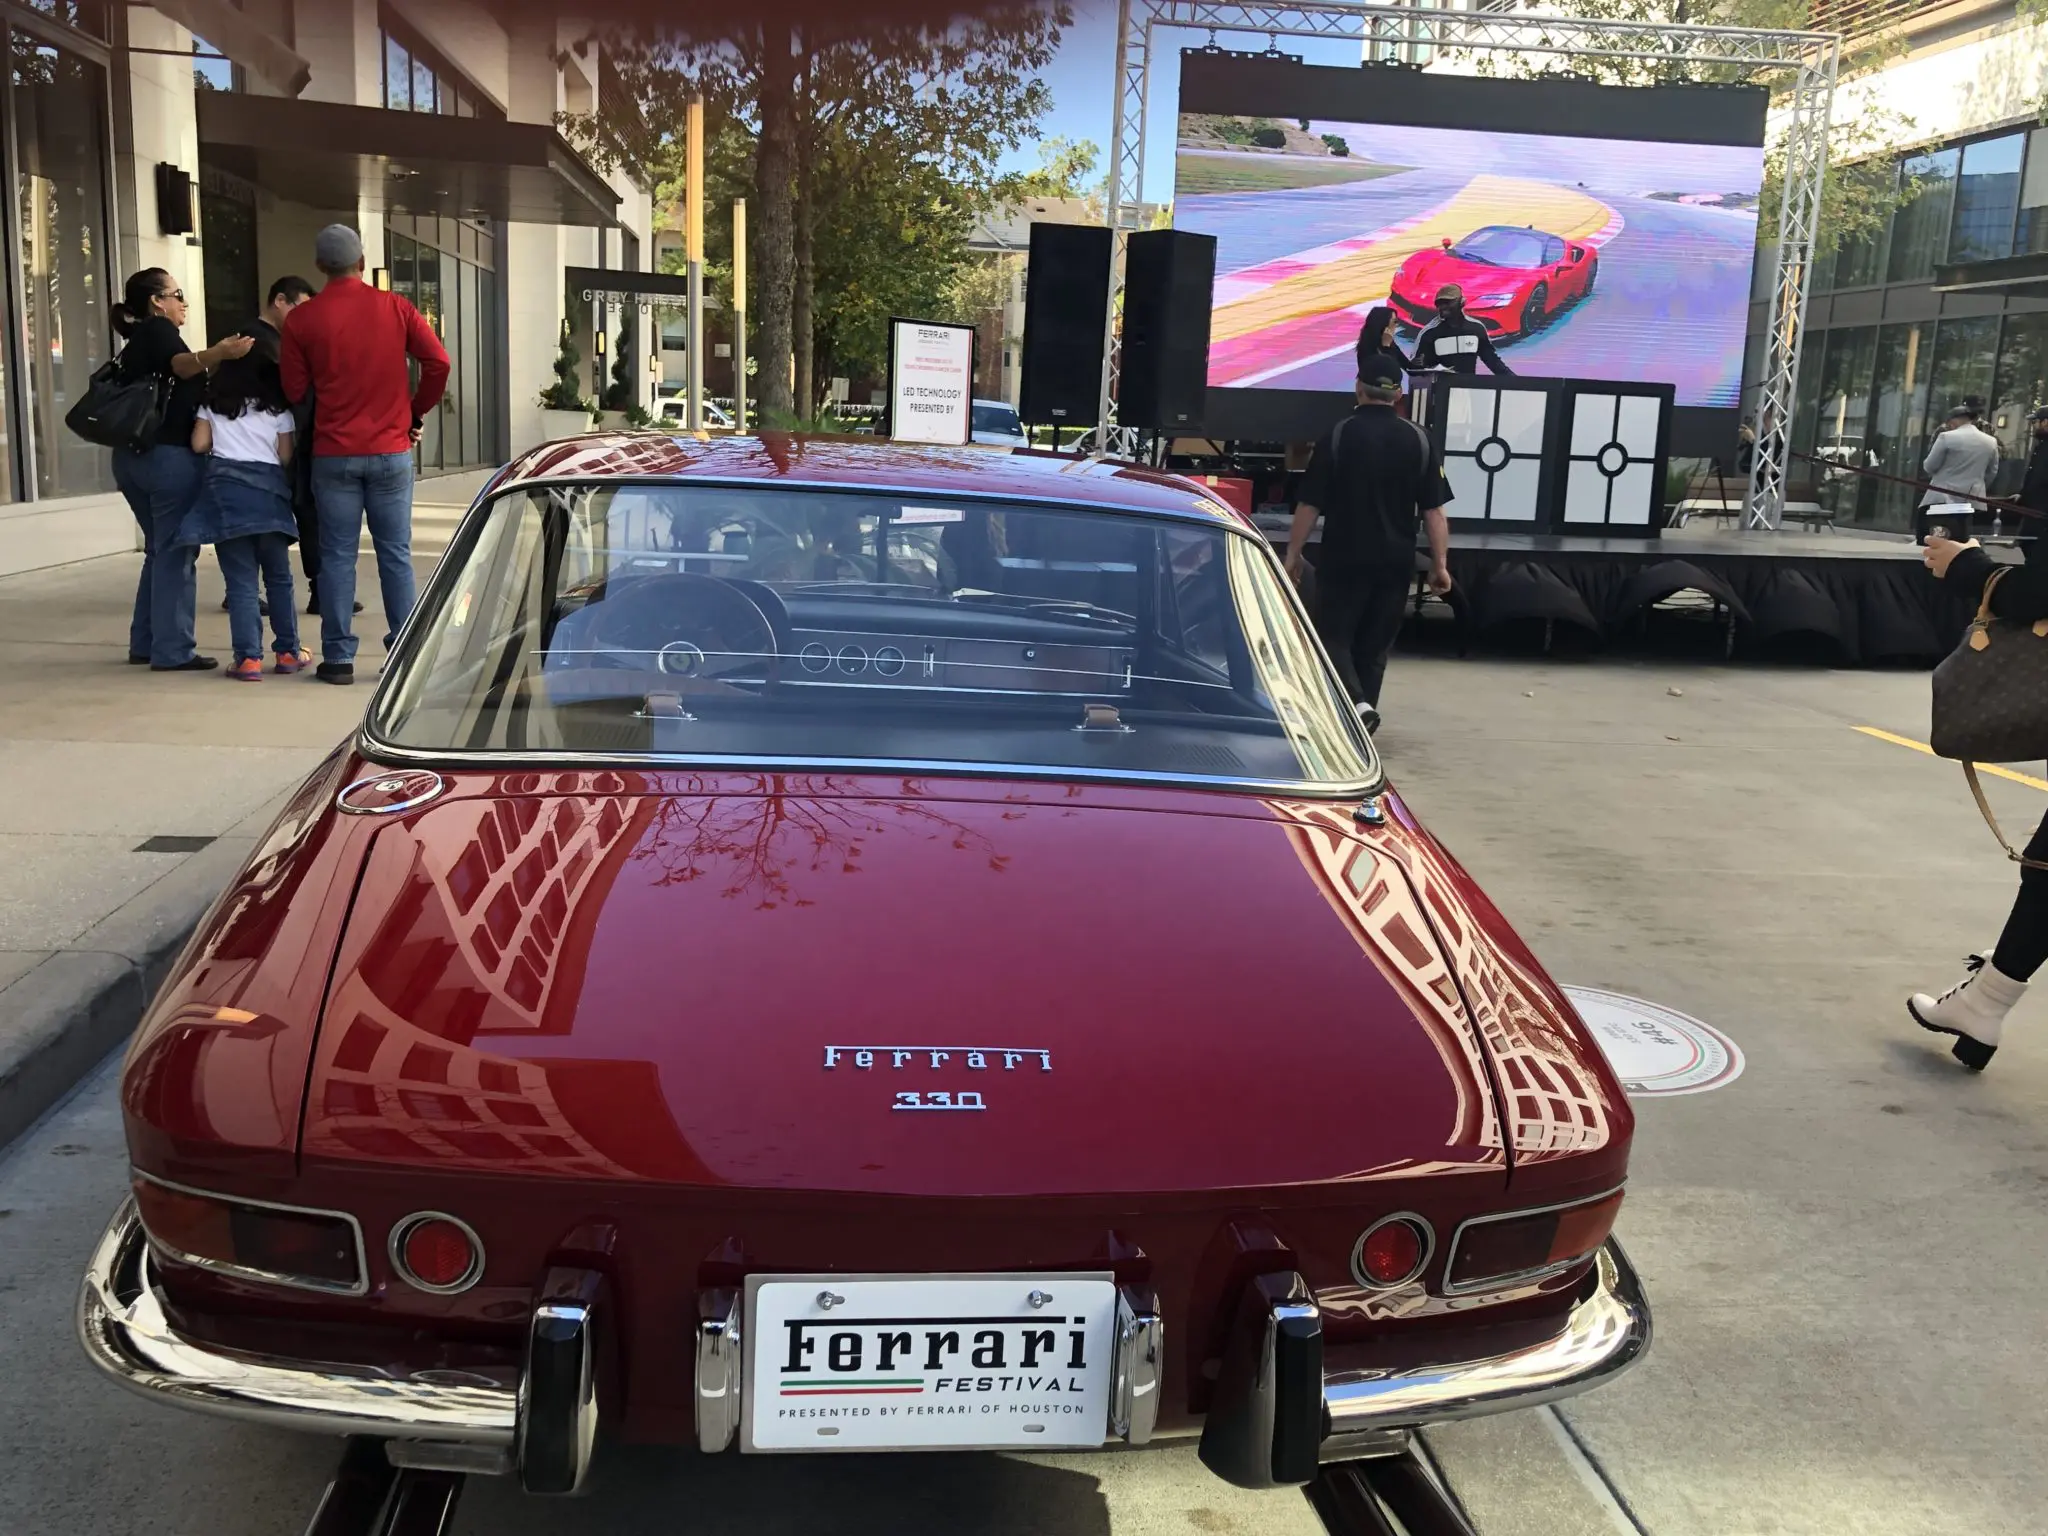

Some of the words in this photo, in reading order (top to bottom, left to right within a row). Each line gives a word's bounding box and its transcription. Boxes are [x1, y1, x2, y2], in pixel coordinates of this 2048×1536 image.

[918, 329, 950, 340] FERRARI
[903, 387, 915, 397] LED
[917, 387, 962, 399] TECHNOLOGY
[909, 403, 945, 414] PRESENTED
[946, 404, 955, 414] BY
[823, 1045, 1053, 1070] Ferrari
[893, 1092, 986, 1109] 330
[780, 1316, 1087, 1373] Ferrari
[935, 1377, 1085, 1393] FESTIVAL
[779, 1407, 871, 1418] PRESENTED
[880, 1407, 899, 1416] BY
[907, 1405, 972, 1415] FERRARI
[981, 1404, 1000, 1414] OF
[1009, 1404, 1084, 1414] HOUSTON
